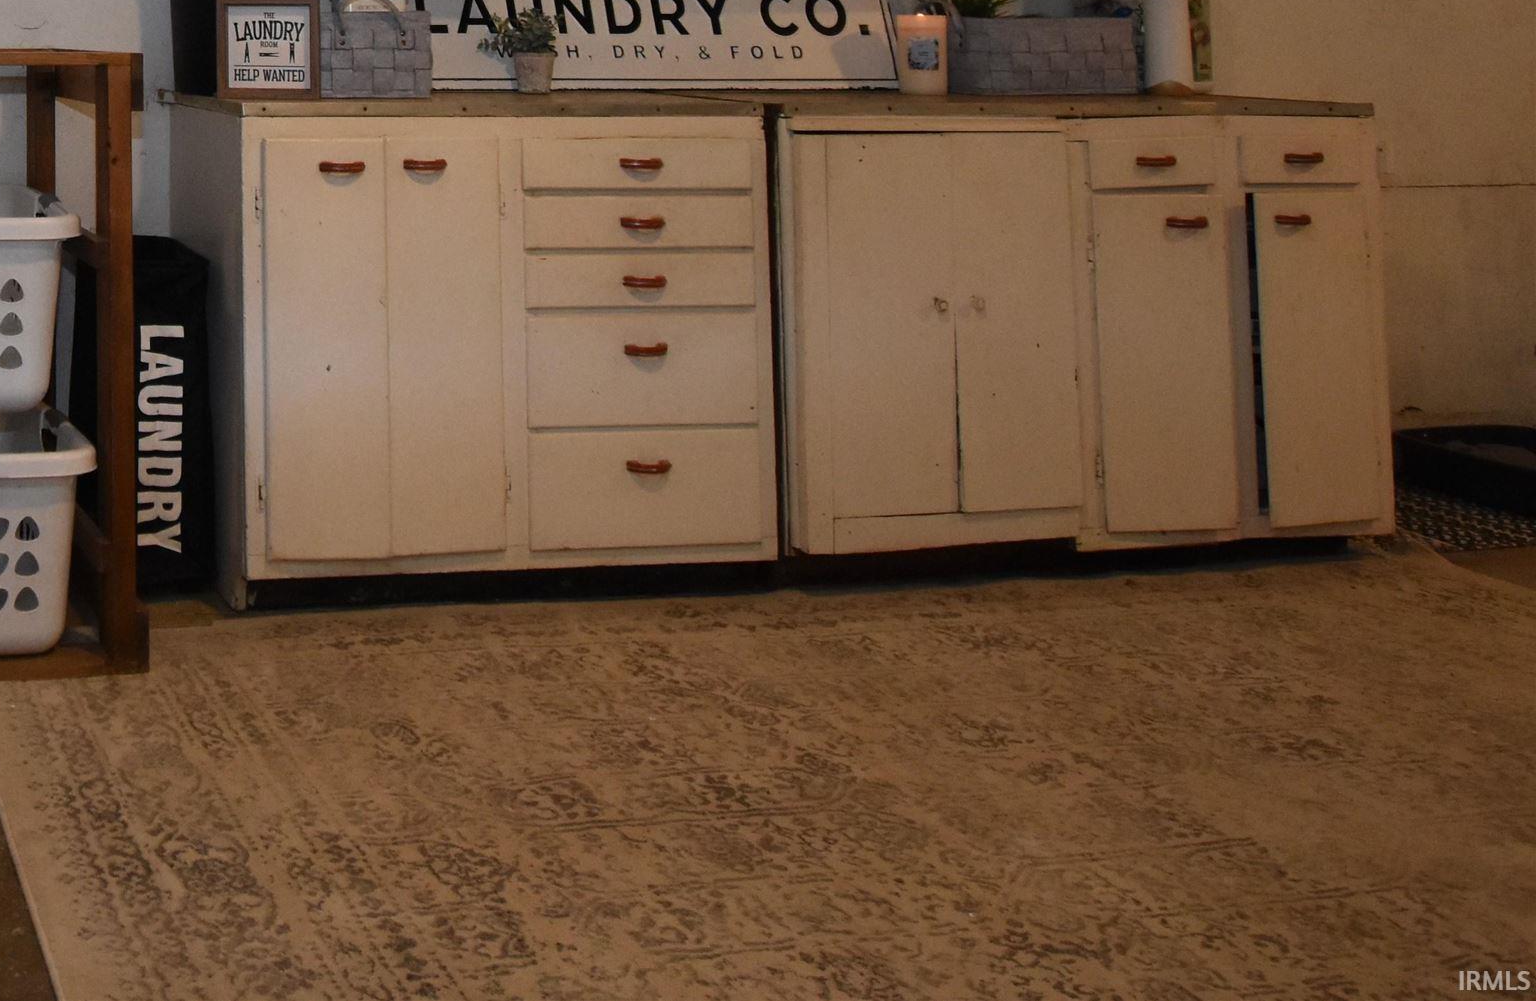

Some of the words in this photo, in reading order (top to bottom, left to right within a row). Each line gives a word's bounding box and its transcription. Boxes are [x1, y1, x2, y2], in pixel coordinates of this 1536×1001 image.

[264, 11, 275, 19] THE
[233, 20, 305, 42] LAUNDRY
[496, 45, 592, 60] WSH,
[614, 45, 680, 62] DRY,
[698, 45, 711, 60] &
[731, 45, 804, 60] FOLD
[234, 68, 260, 82] HELP
[263, 69, 305, 83] WANTED
[136, 325, 185, 553] LAUNDRY
